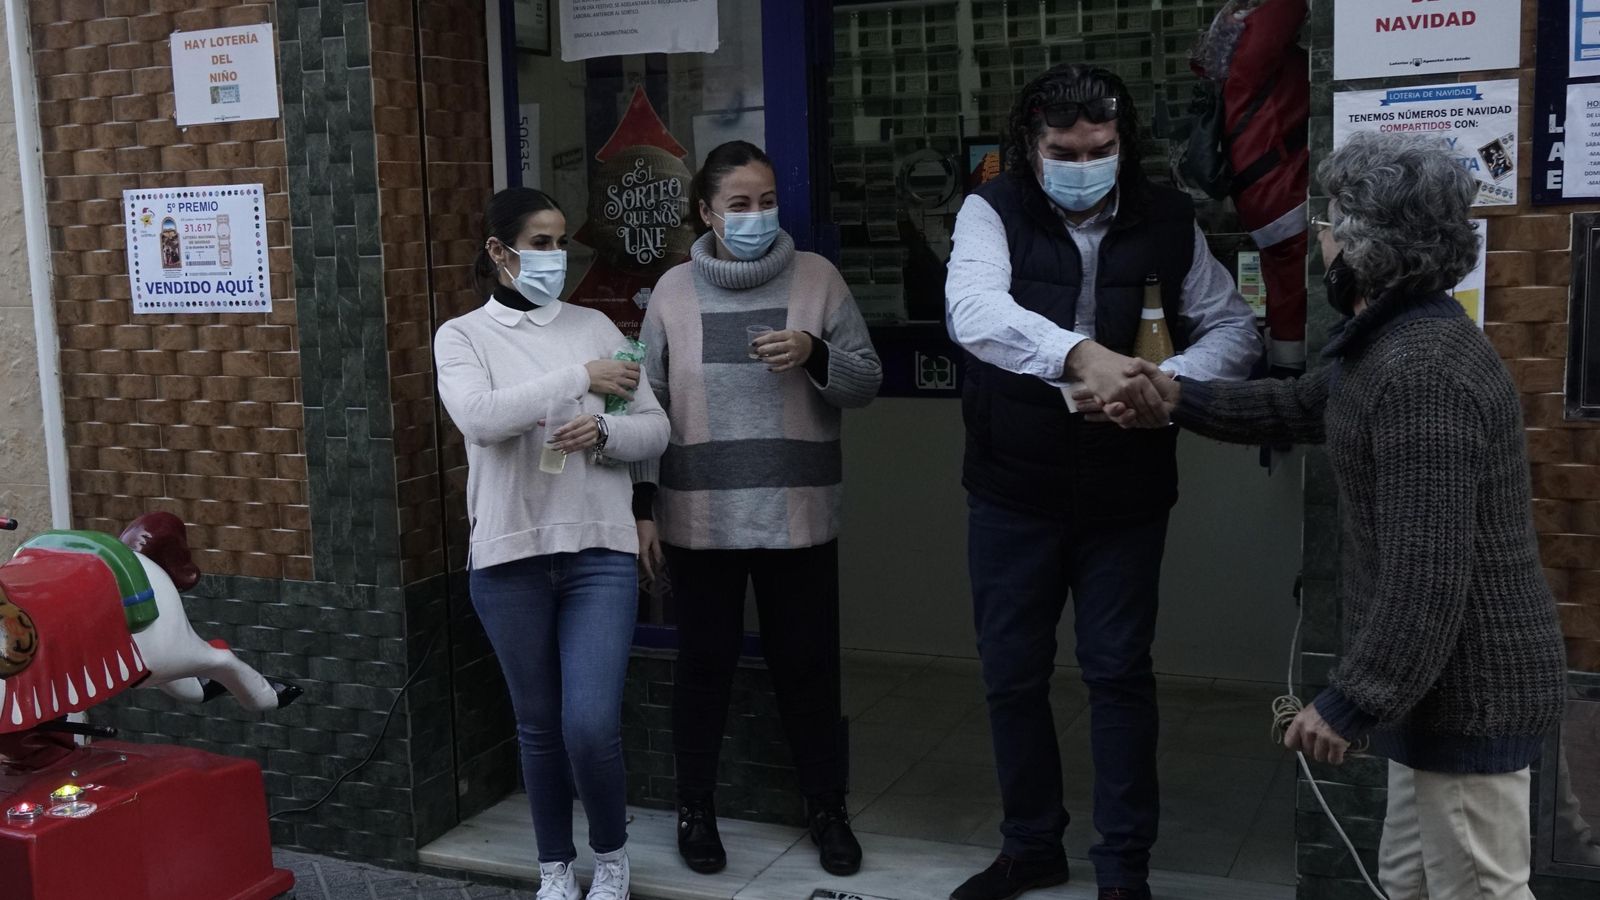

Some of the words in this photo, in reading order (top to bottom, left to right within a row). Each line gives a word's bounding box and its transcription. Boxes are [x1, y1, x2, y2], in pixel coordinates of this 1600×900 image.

[1375, 10, 1476, 33] NAVIDAD
[184, 39, 206, 50] HAY
[210, 32, 259, 48] LOTERÍA
[211, 54, 233, 65] DEL
[209, 70, 238, 83] NIÑO
[1389, 91, 1421, 101] LOTERIA
[1423, 90, 1433, 98] DE
[1435, 88, 1472, 97] NAVIDAD
[1586, 100, 1600, 108] HO
[1349, 112, 1395, 123] TENEMOS
[1397, 109, 1446, 120] NÚMEROS
[1450, 108, 1464, 117] DE
[1467, 105, 1512, 116] NAVIDAD
[1380, 121, 1452, 133] COMPARTIDOS
[1454, 120, 1479, 129] CON:
[622, 158, 656, 187] EL
[178, 201, 219, 213] PREMIO
[604, 177, 682, 220] SORTEO
[623, 210, 650, 228] QUE
[653, 201, 681, 228] NOS
[184, 223, 212, 233] 31.617
[616, 226, 668, 263] UNE
[145, 280, 211, 295] VENDIDO
[216, 275, 254, 297] AQUÍ
